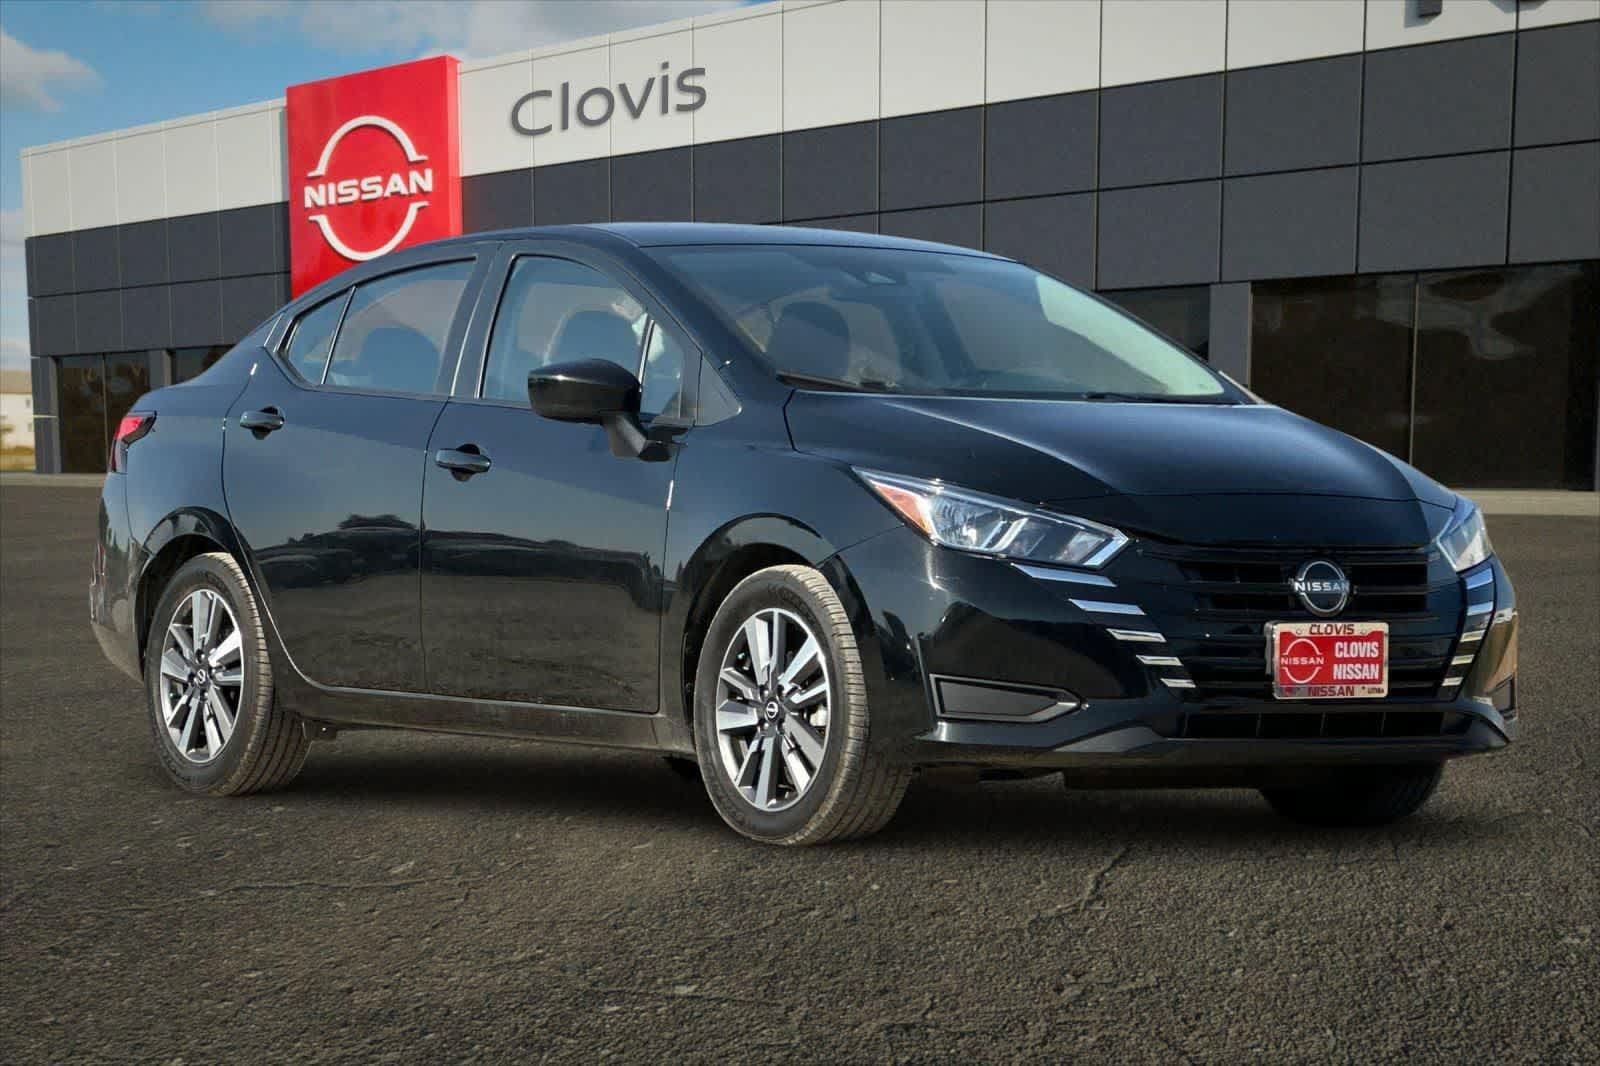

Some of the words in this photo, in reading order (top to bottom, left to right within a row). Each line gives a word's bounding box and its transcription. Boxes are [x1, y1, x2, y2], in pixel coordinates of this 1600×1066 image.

[511, 62, 707, 136] Clovis
[304, 168, 433, 209] NISSAN
[1294, 581, 1349, 592] NISSAN
[1309, 624, 1354, 635] CLOVIS
[1335, 642, 1379, 658] CLOVIS
[1281, 657, 1324, 665] NISSAN
[1333, 664, 1379, 680] NISSAN
[1308, 686, 1354, 696] NISSAN
